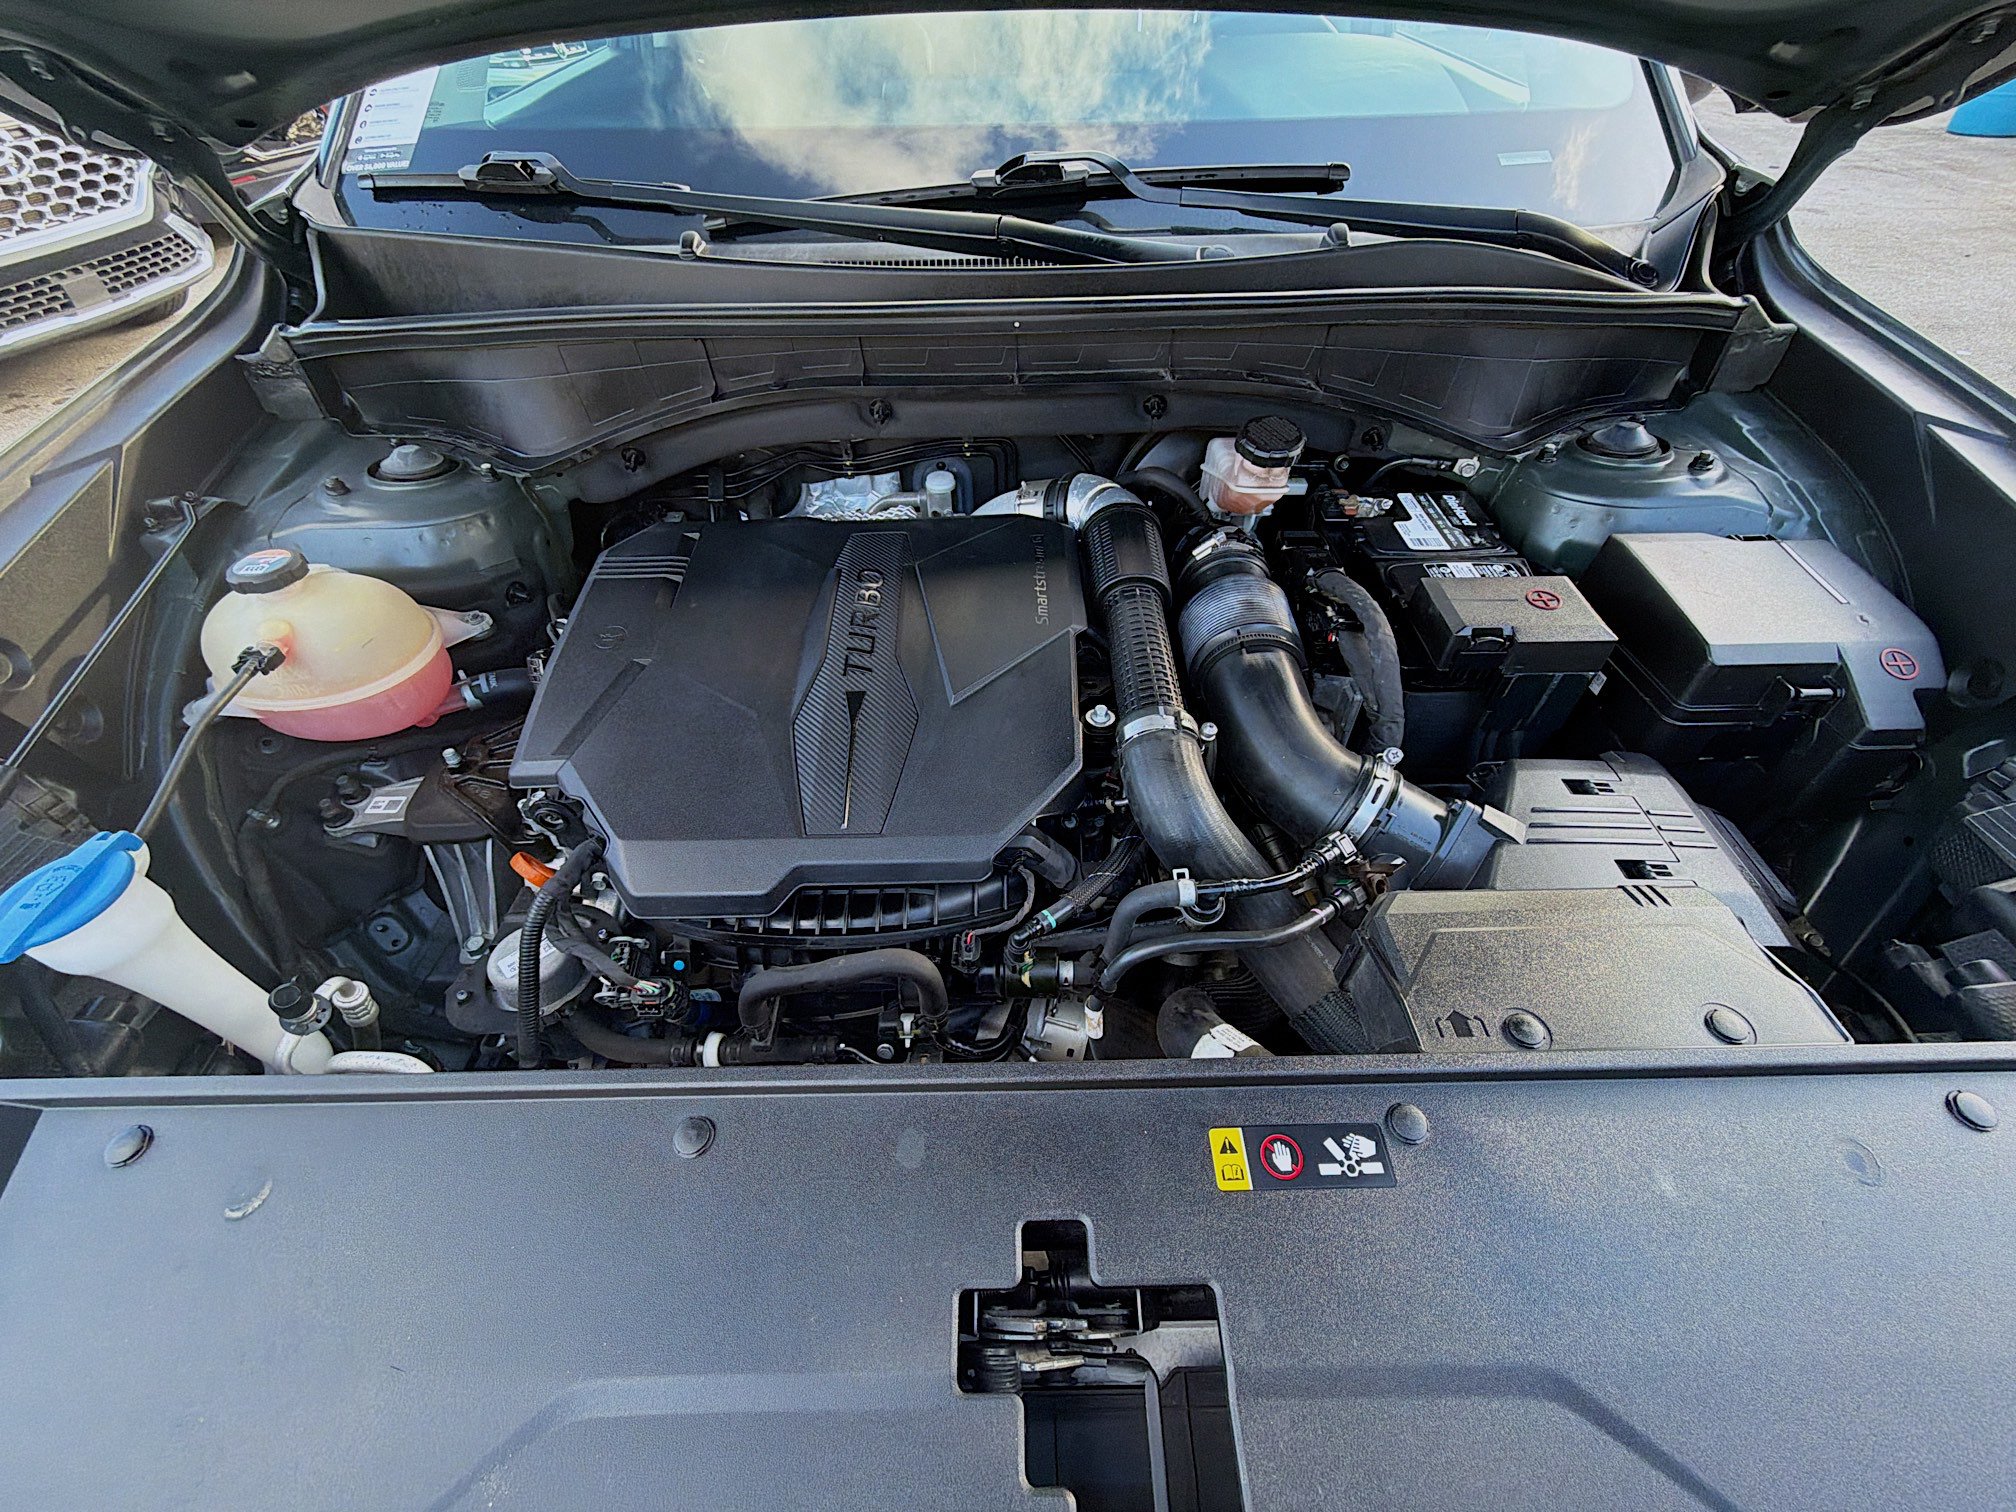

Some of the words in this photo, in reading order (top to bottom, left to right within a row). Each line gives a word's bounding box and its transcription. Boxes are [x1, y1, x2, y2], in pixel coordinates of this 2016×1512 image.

[346, 163, 363, 172] OVER
[1442, 494, 1477, 527] DieHard
[843, 568, 885, 677] TURBO
